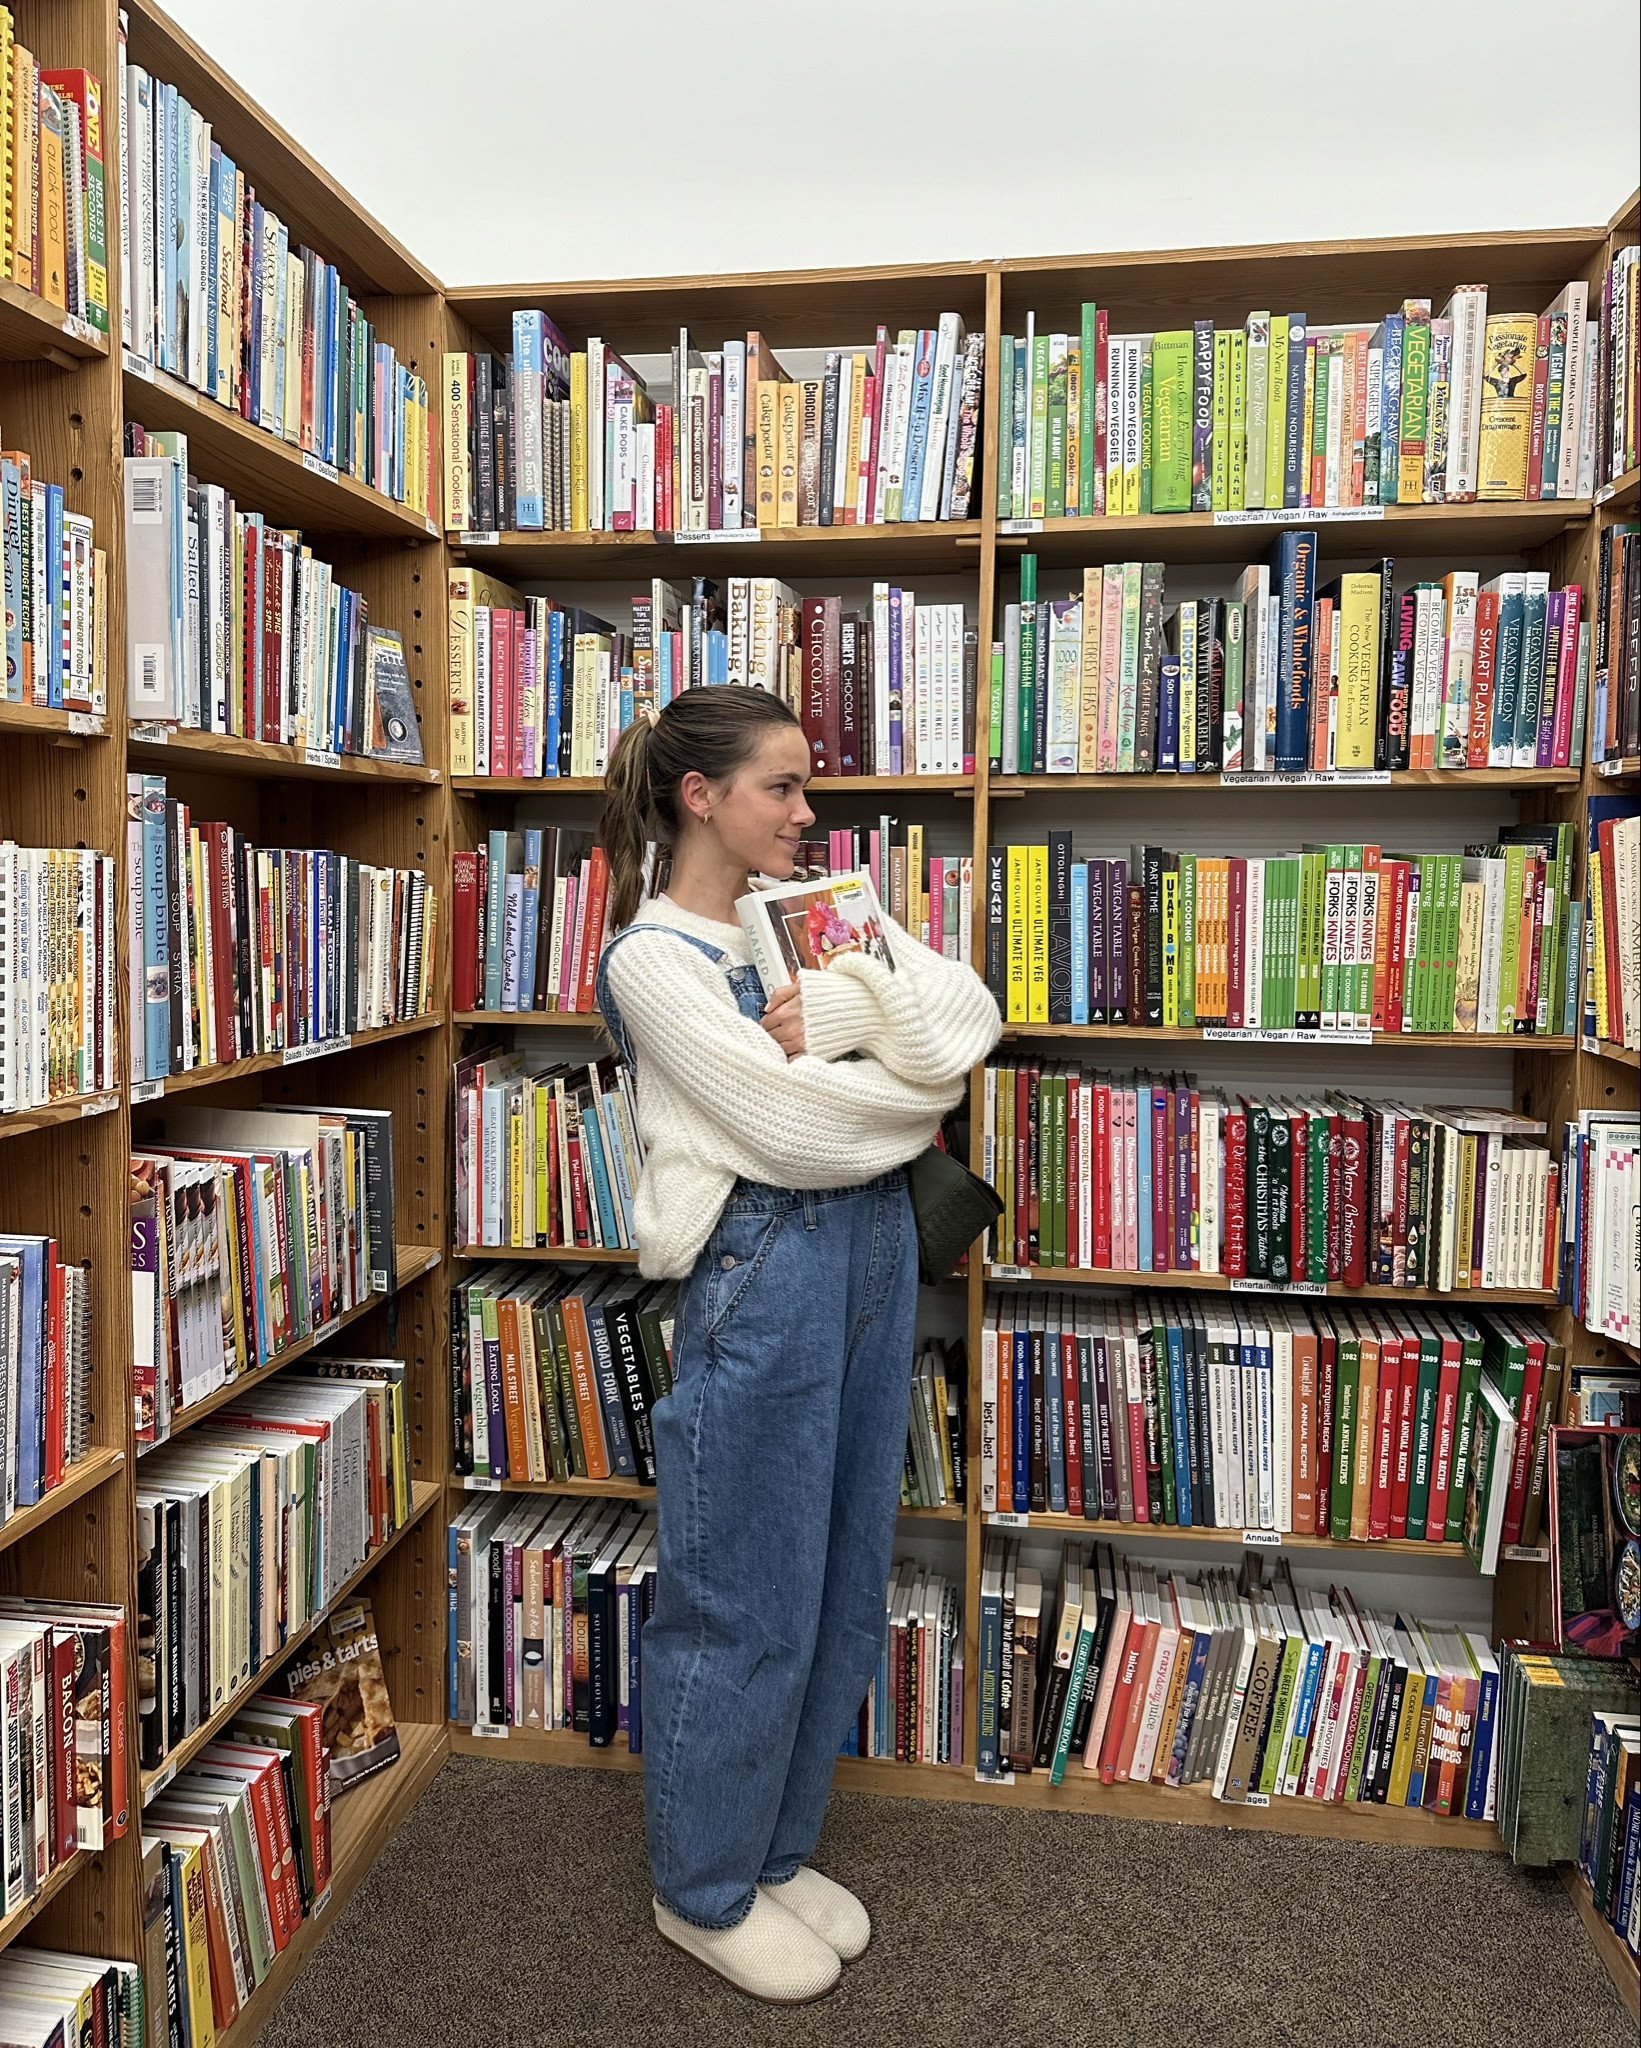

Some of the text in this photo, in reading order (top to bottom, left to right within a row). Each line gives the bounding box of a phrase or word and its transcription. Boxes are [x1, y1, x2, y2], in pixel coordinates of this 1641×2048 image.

[87, 74, 101, 152] ZONE
[47, 143, 60, 244] quick food
[220, 247, 231, 318] Seafood
[1155, 340, 1188, 351] Bittman
[523, 358, 532, 410] ultimate
[1110, 348, 1120, 462] RUNNING on VEGGIES
[1127, 348, 1137, 463] RUNNING on VEGGIES
[1196, 330, 1212, 428] HAPPY FOOD
[1368, 360, 1380, 428] SUPERGREENS
[1405, 328, 1425, 439] VEGETARIAN
[619, 406, 628, 458] CAKE POPS
[804, 382, 818, 440] CHOCOLATE
[1032, 342, 1044, 491] VEGAN FOR EVERYBODY
[1142, 382, 1151, 470] VEGAN COOKING
[1155, 375, 1176, 462] Vegetarian
[1287, 365, 1299, 471] NATURALLY NOURISHED
[305, 456, 314, 468] Fish
[451, 379, 462, 510] 400 Sensational Cookies
[525, 461, 533, 492] book
[1217, 513, 1263, 522] Vegetarian
[188, 538, 198, 600] Salted
[1292, 542, 1311, 602] Organic
[728, 583, 747, 672] Baking
[750, 584, 772, 676] Baking
[1348, 624, 1359, 682] COOKING
[1415, 602, 1427, 694] BECOMING VEGAN
[811, 619, 826, 718] CHOCOLATE
[1022, 631, 1032, 687] VEGETARIAN
[1083, 641, 1097, 719] FOREST FEAST
[1291, 624, 1308, 710] Wholefoods
[1360, 644, 1370, 726] VEGETARIAN
[1473, 628, 1493, 738] SMART PLANTS
[844, 670, 853, 732] CHOCOLATE
[1346, 696, 1354, 733] Everyone
[151, 844, 166, 961] soup bible
[991, 857, 1002, 917] VEGAN
[1423, 889, 1433, 907] veg
[504, 893, 517, 992] Wild about Cupcakes
[524, 916, 534, 949] Perfect
[747, 924, 768, 976] NAKED
[1012, 919, 1023, 982] ULTIMATE VEG
[1051, 903, 1072, 1009] FLAVOR
[1570, 948, 1578, 978] INFUSED
[522, 951, 531, 979] Scoop
[1568, 981, 1576, 1004] WATER
[1206, 1030, 1252, 1038] Vegetarian
[1344, 1161, 1360, 1262] Merry Christmas
[1233, 1280, 1283, 1291] Entertaining
[1293, 1284, 1324, 1293] Holiday
[473, 1329, 487, 1439] PERFECT Vegetables
[488, 1345, 500, 1415] EATING LOCAL
[505, 1353, 518, 1405] MILK STREET
[594, 1329, 620, 1404] BROAD FORK
[616, 1312, 644, 1412] VEGETABLES
[1384, 1356, 1400, 1364] 1983
[1403, 1351, 1419, 1360] 1998
[1421, 1354, 1438, 1363] 1999
[1443, 1360, 1460, 1368] 2000
[1509, 1362, 1524, 1370] 2009
[1246, 1533, 1280, 1543] Annuals
[286, 1634, 378, 1692] pies & tarts
[575, 1620, 587, 1675] bountiful
[61, 1672, 74, 1749] BACON
[116, 1702, 125, 1756] Chicken
[982, 1670, 995, 1737] MODERN JUICING
[1245, 1667, 1270, 1738] COFFEE
[1436, 1704, 1471, 1728] the big
[1430, 1741, 1462, 1766] juices
[1433, 1724, 1472, 1745] book of
